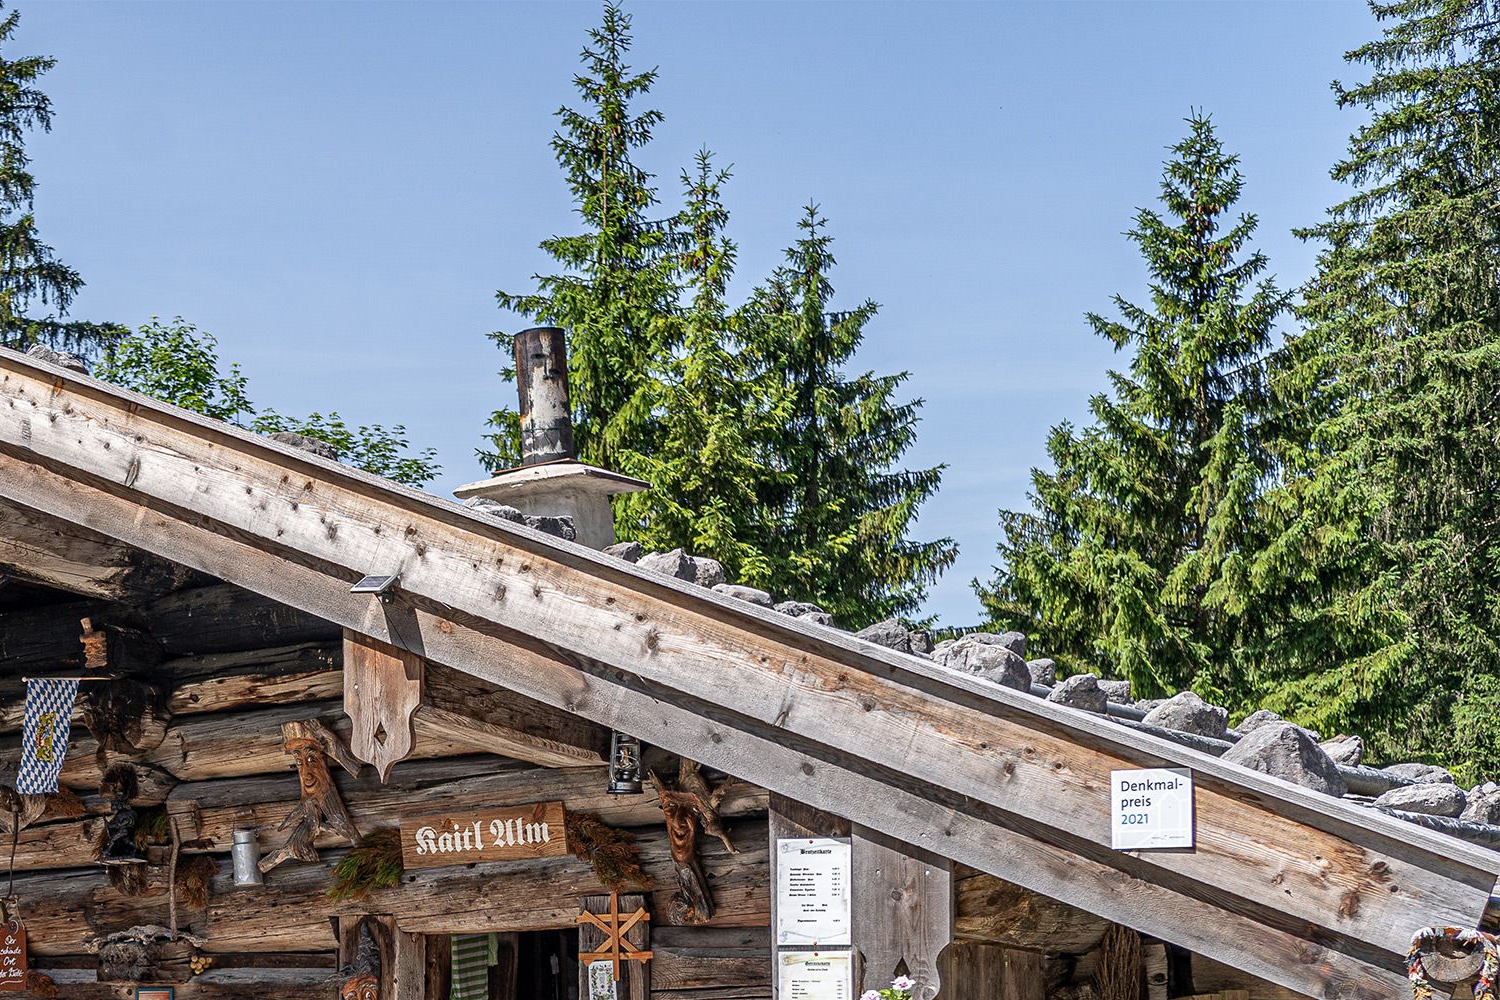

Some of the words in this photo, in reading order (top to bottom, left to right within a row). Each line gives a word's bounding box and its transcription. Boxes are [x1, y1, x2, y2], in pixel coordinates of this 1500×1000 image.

[1121, 777, 1183, 792] Denkmal-
[1121, 795, 1152, 811] preis
[1121, 813, 1149, 825] 2021
[415, 820, 484, 855] Kaitl
[489, 817, 551, 848] Alm
